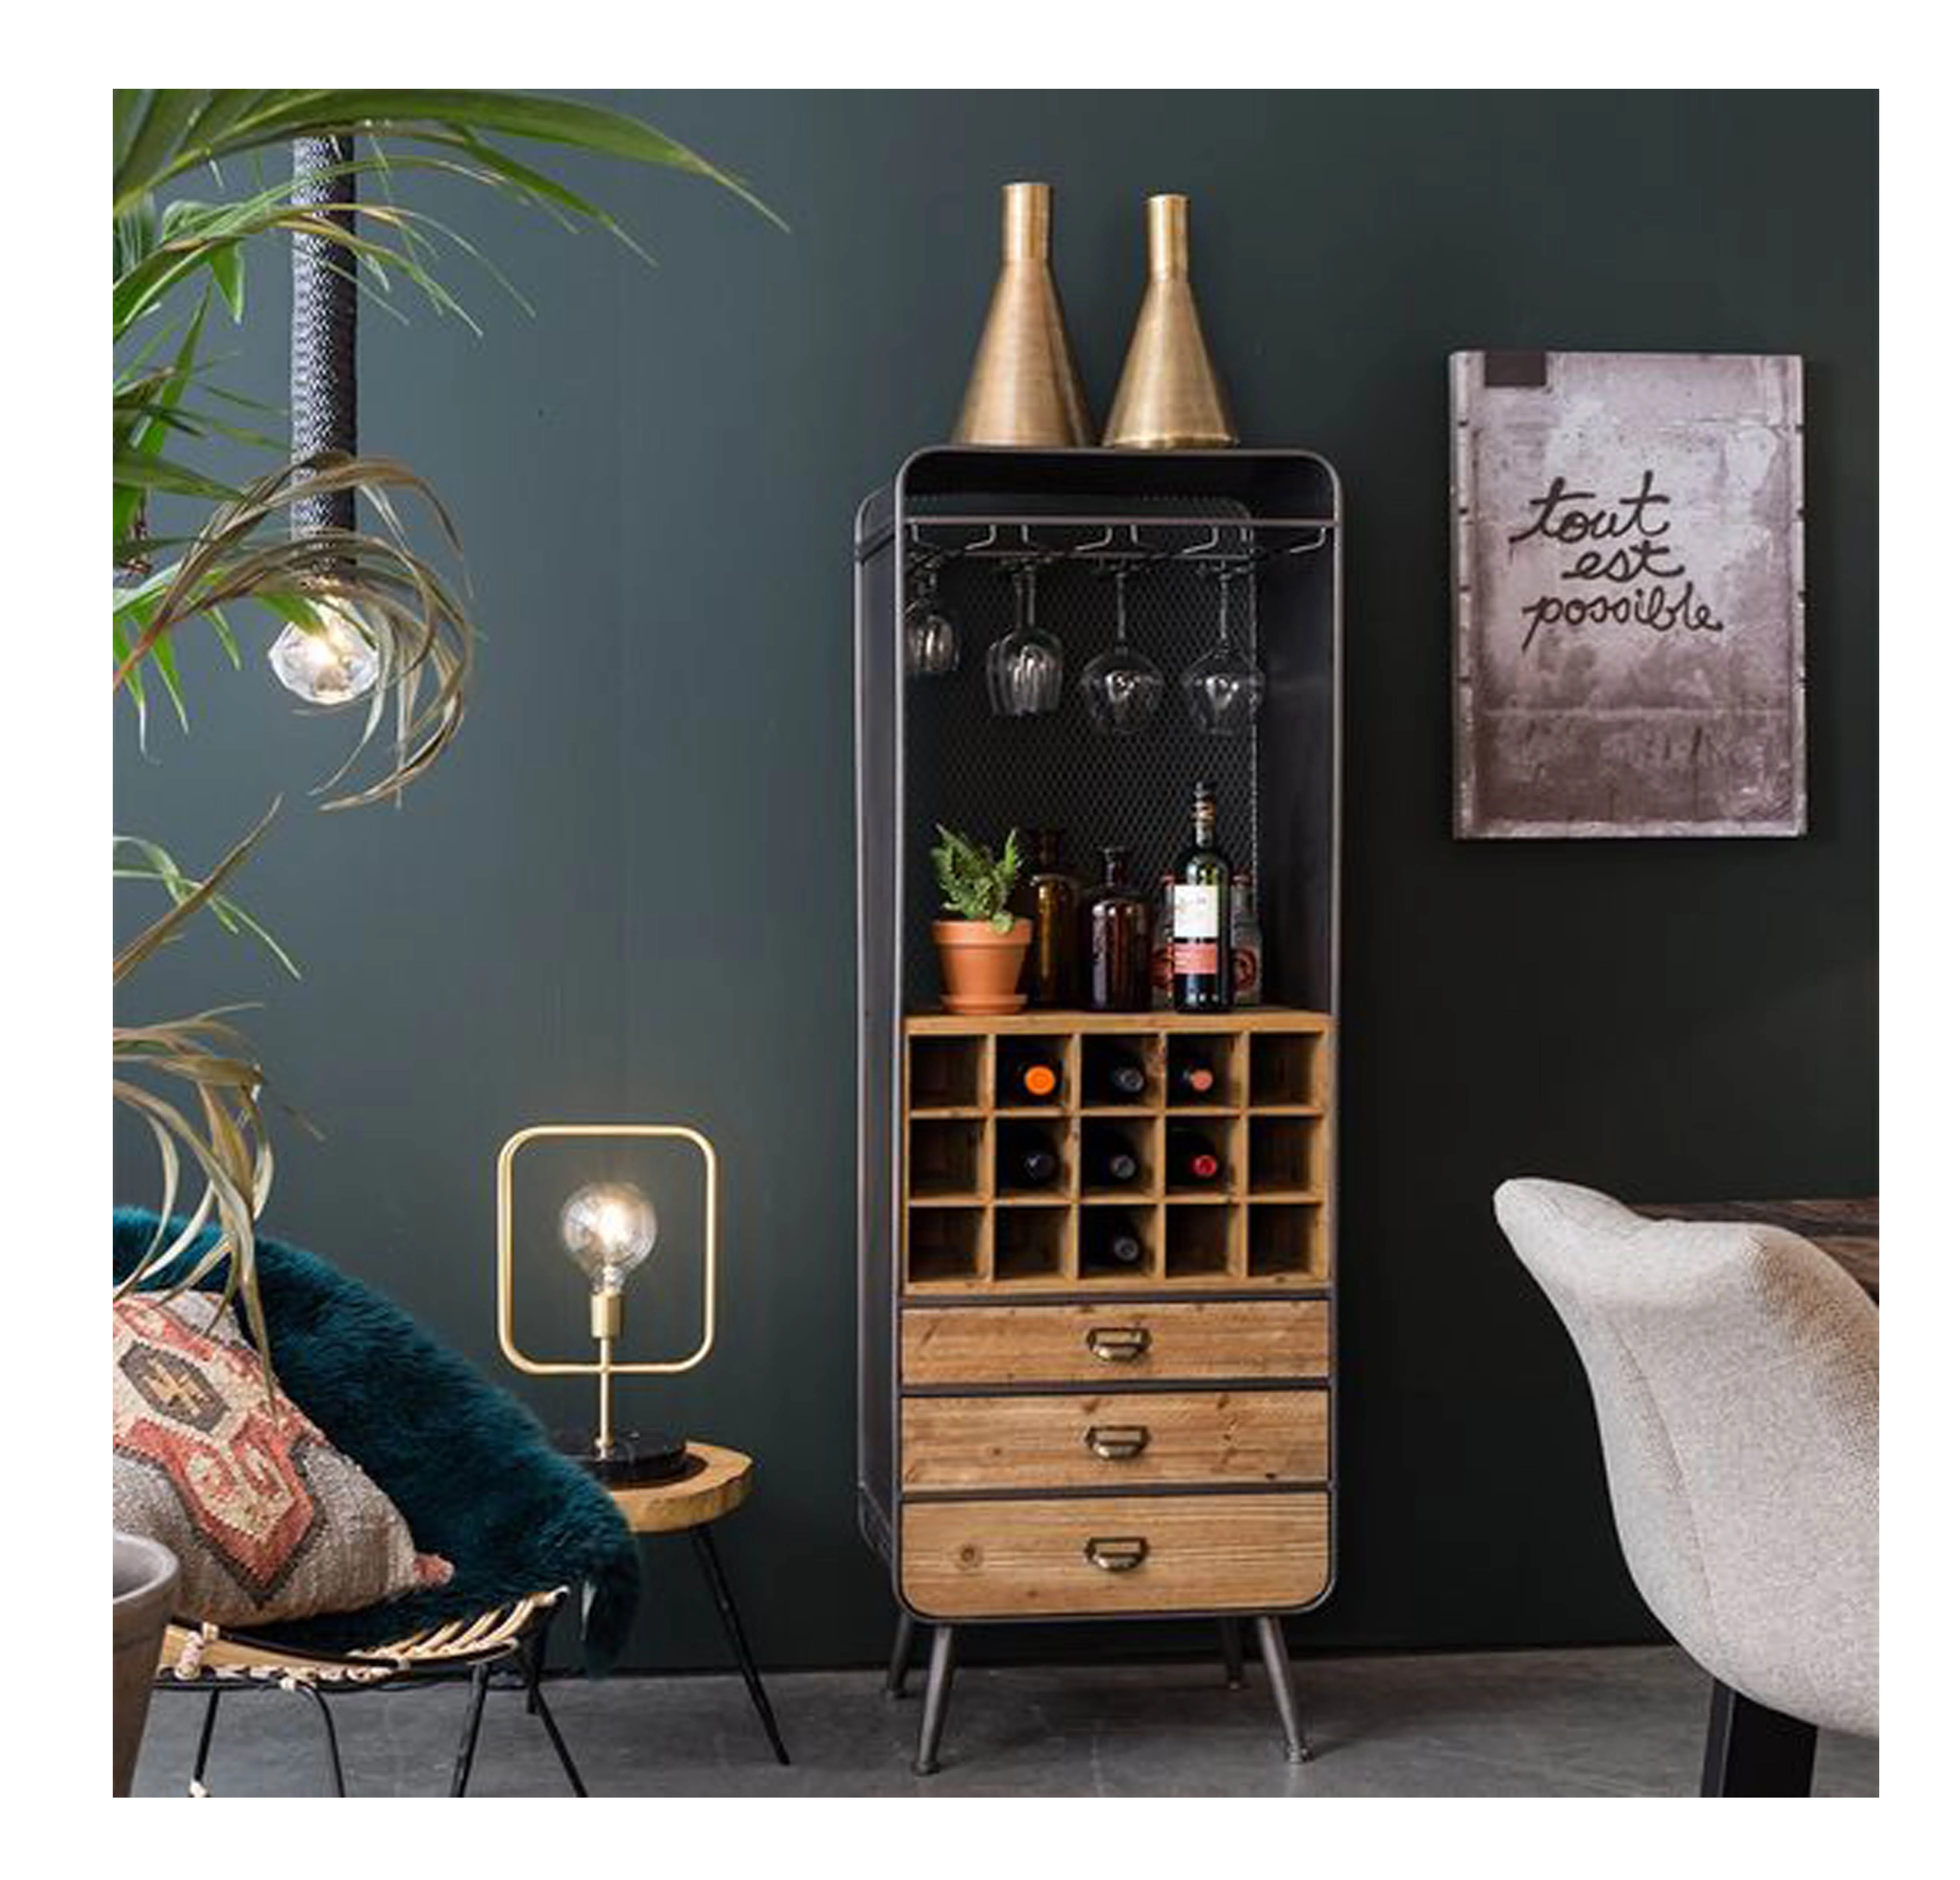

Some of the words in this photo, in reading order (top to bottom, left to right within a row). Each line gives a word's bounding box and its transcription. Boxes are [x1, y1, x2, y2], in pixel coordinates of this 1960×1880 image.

[1509, 470, 1670, 544] tout
[1562, 540, 1685, 582] est
[1521, 582, 1724, 651] possible
